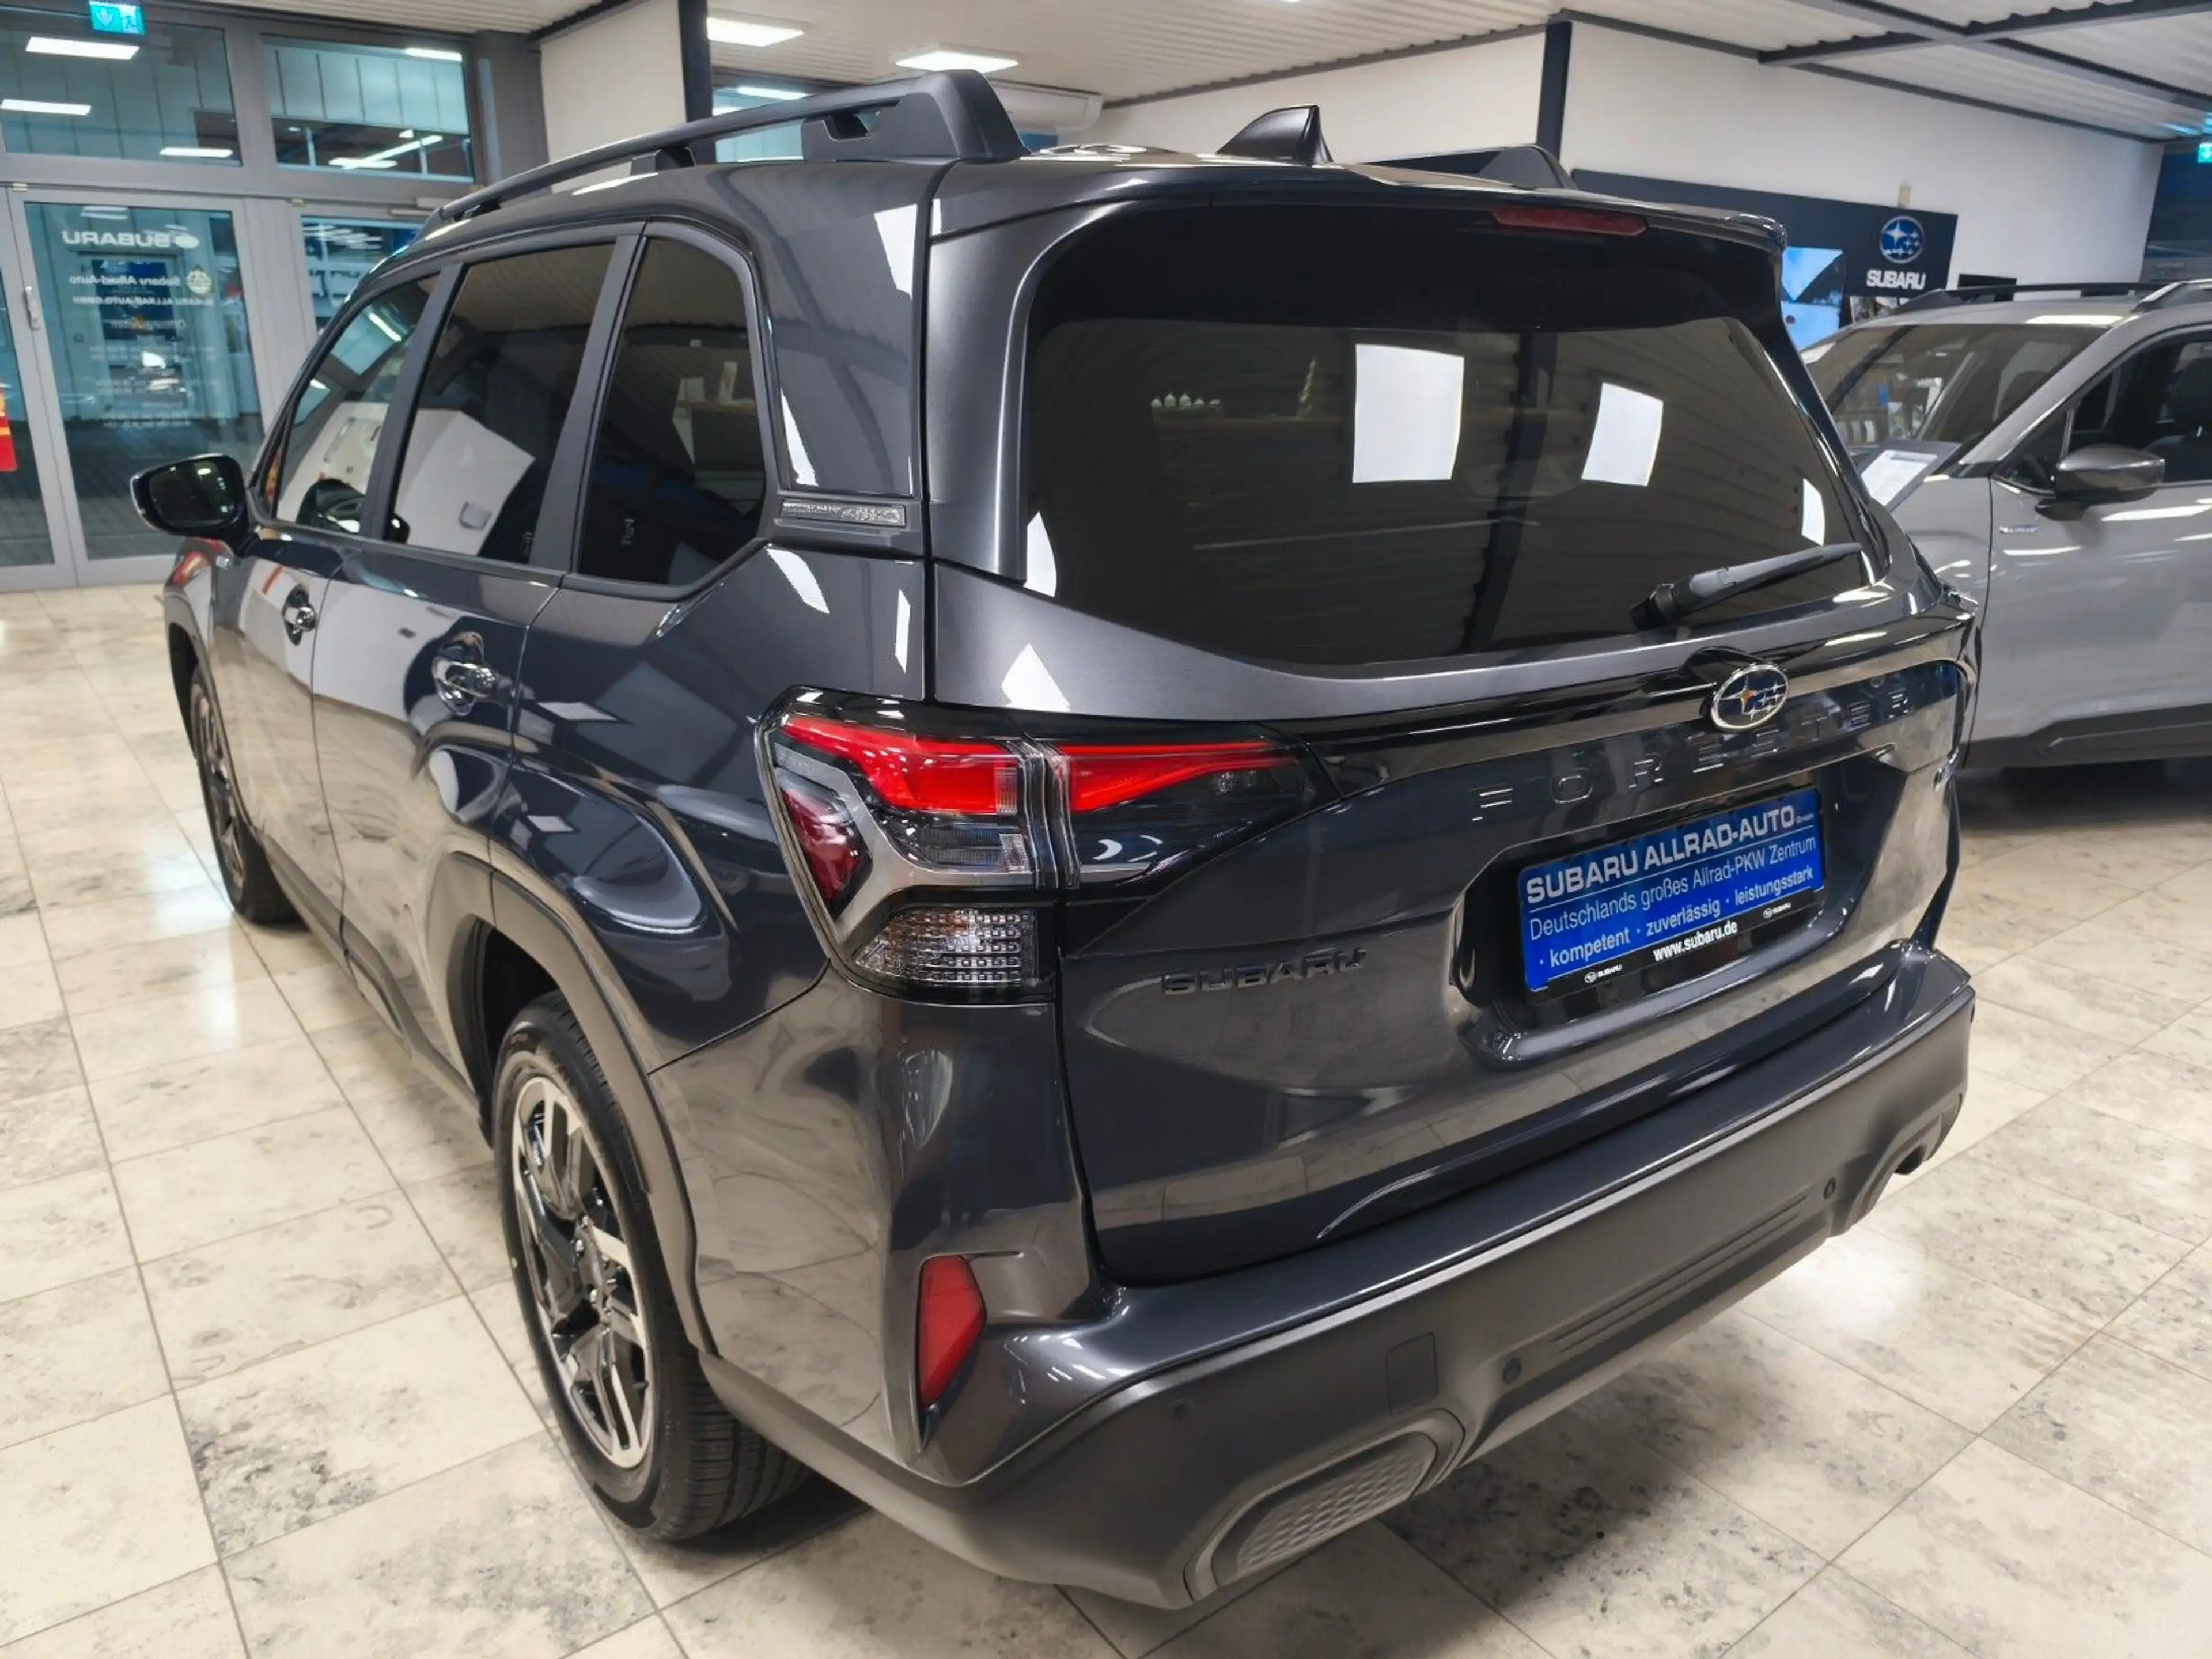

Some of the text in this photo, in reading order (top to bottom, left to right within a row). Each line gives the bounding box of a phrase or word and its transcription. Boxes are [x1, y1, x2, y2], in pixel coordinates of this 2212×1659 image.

[1866, 269, 1926, 290] SUBARU
[1472, 691, 1914, 822] FORESTER
[1527, 805, 1794, 904] SUBARU ALLRAD-AUTO
[1530, 836, 1816, 941] Deutschlands großes Allrad-PKW Zentrum
[1550, 865, 1813, 967] kompetent zuverlässig leistungsstark
[1653, 921, 1738, 961] www.subaru.de
[1161, 948, 1367, 995] SUBARU
[1597, 964, 1622, 978] SUBARU
